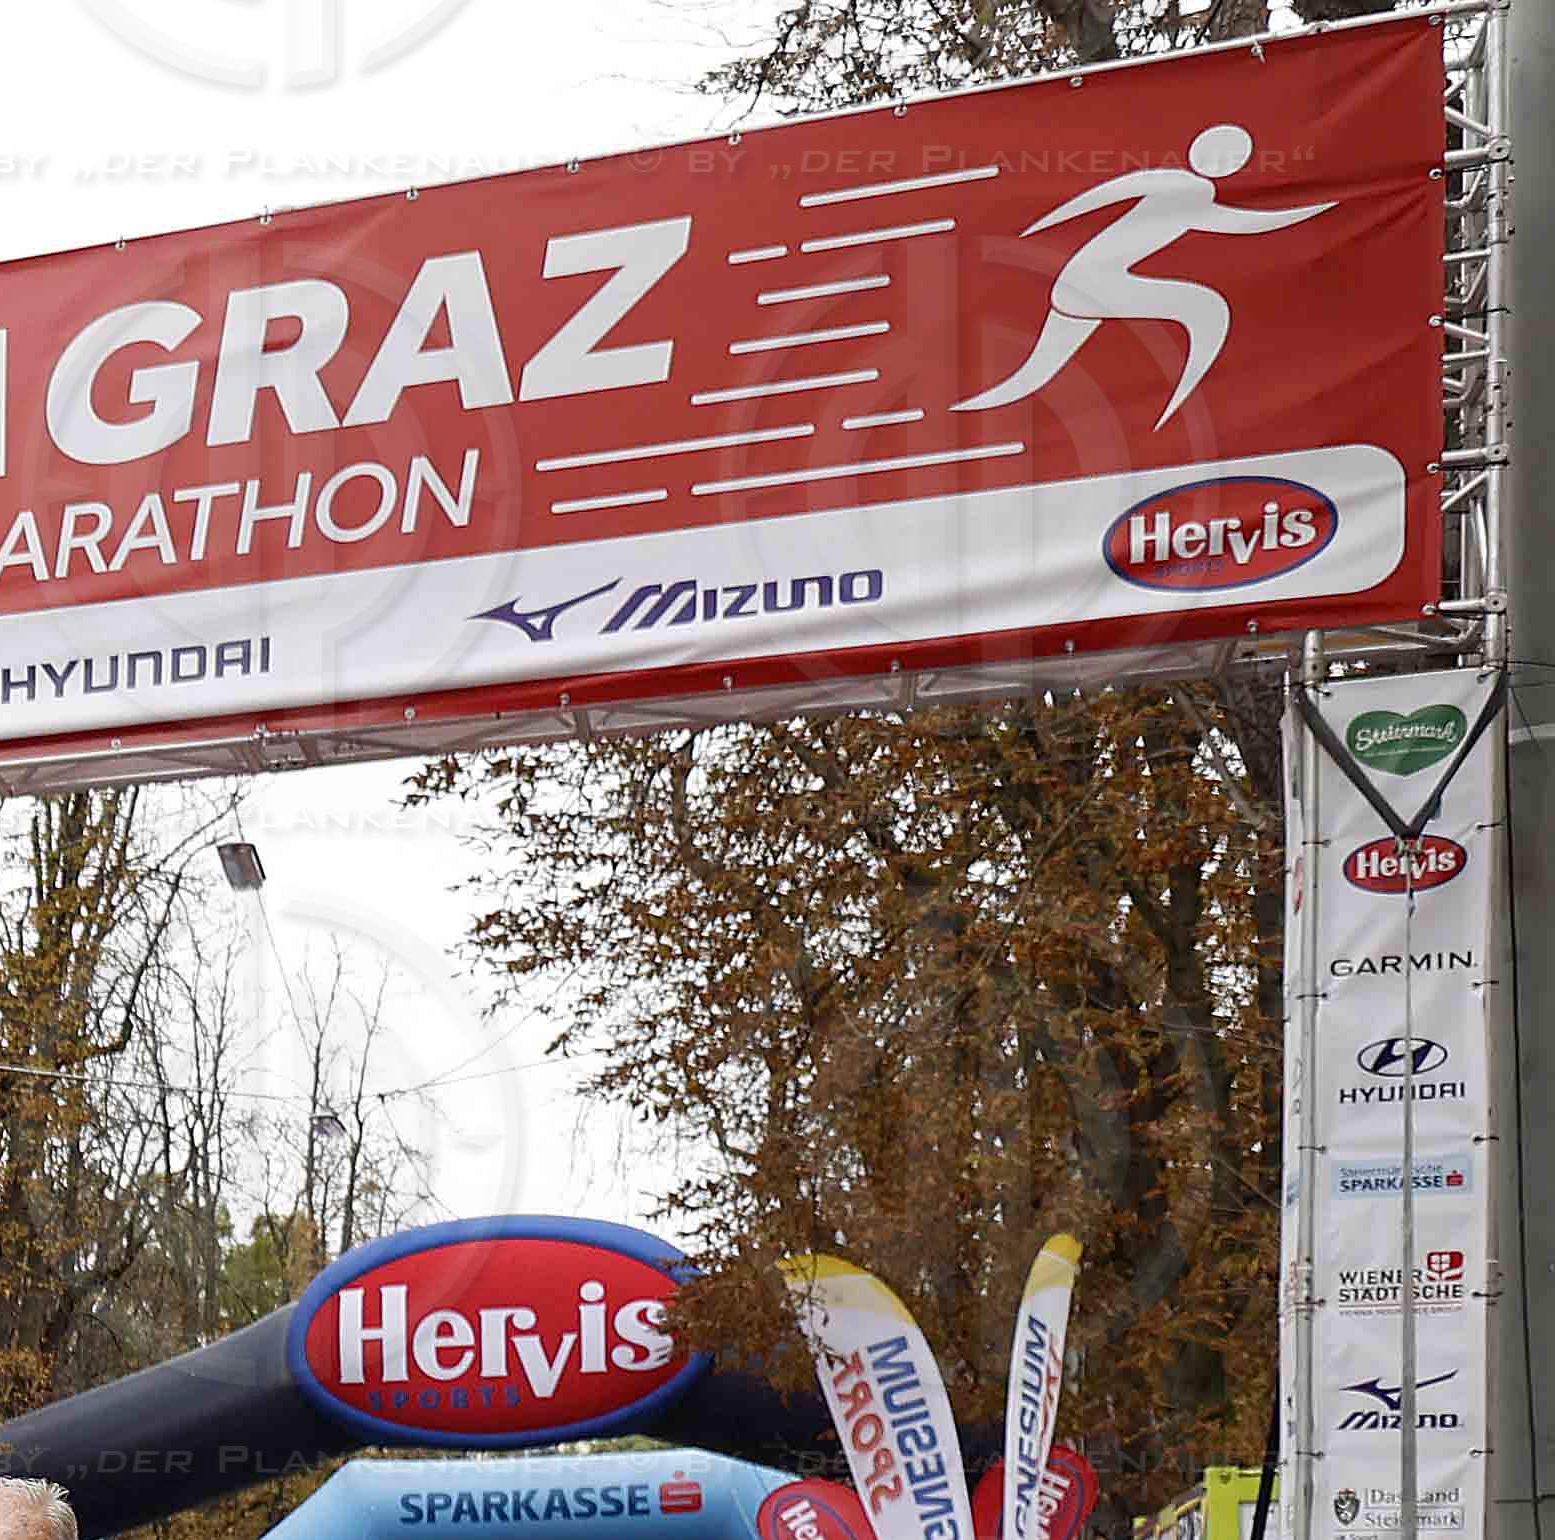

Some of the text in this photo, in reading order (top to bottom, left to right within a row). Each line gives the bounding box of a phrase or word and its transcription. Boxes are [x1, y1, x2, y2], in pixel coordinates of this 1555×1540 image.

[46, 213, 693, 467] GRAZ
[1128, 501, 1318, 577] Hervis
[1, 638, 271, 705] HYUNDAI
[1356, 844, 1457, 881] Hervis
[1330, 951, 1475, 977] GARMIN
[1340, 1269, 1422, 1285] WIENR
[338, 1280, 675, 1399] Hervis
[400, 1484, 650, 1526] SPARKASSE
[1416, 1488, 1459, 1503] and
